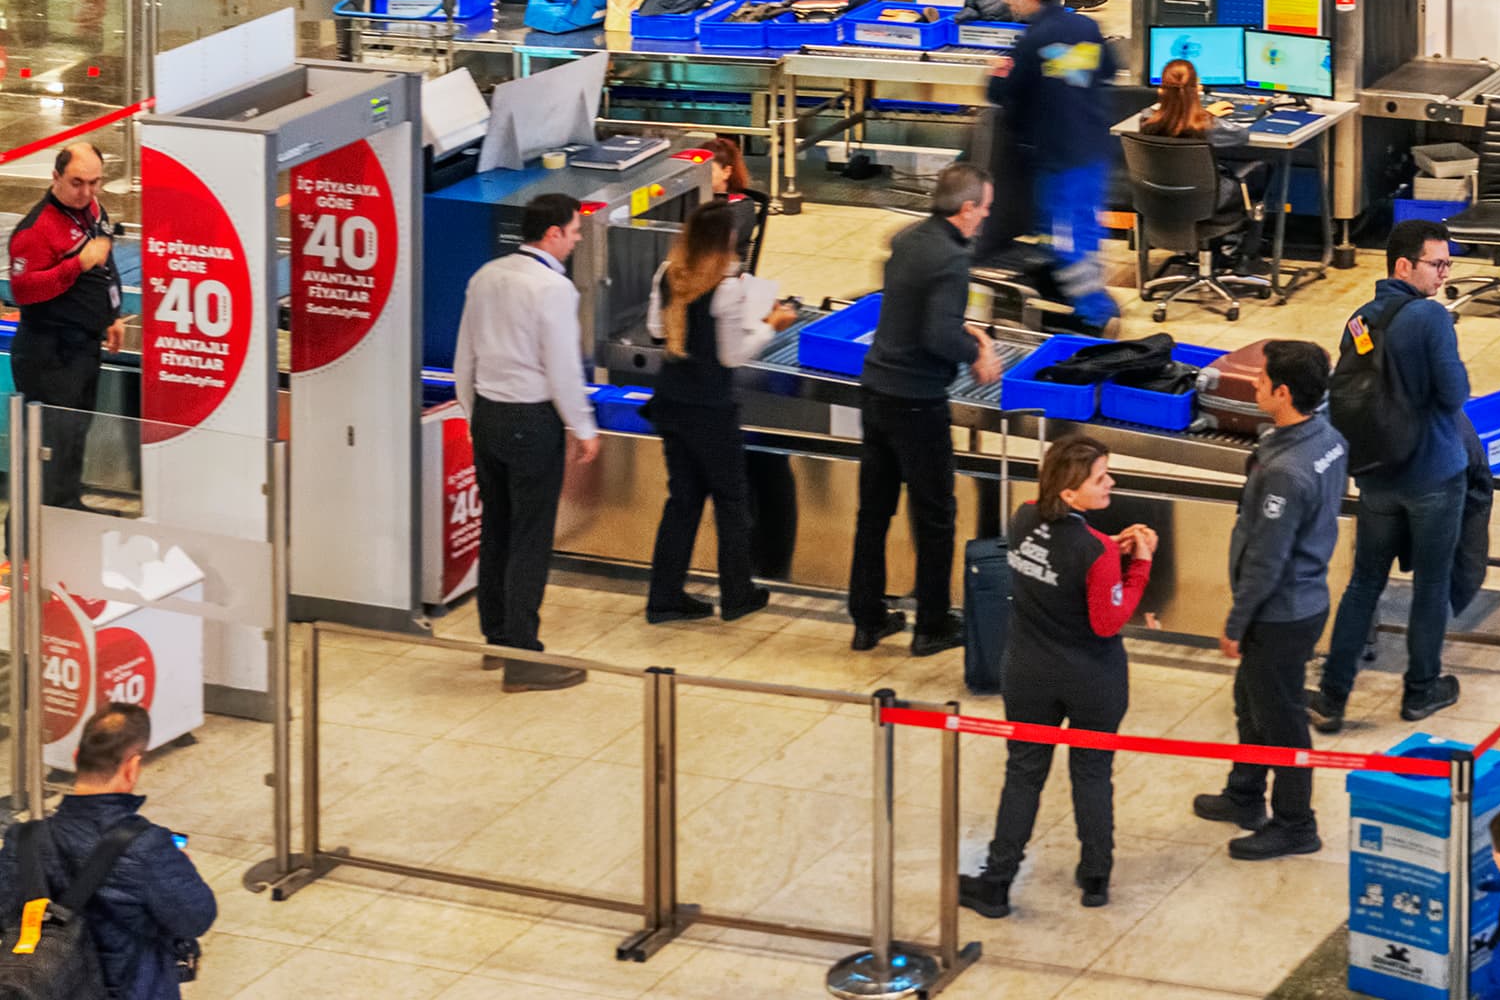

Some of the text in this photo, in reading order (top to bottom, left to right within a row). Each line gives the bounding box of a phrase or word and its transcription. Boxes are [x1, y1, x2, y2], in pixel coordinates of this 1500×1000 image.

[316, 178, 380, 197] PİYASAYA
[316, 194, 354, 210] GÖRE
[147, 237, 234, 260] İÇ PİYASAYA
[298, 213, 378, 271] %40
[168, 256, 207, 274] GÖRE
[302, 270, 375, 288] AVANTAJLI
[308, 284, 370, 303] FİYATLAR
[150, 277, 233, 337] %40
[154, 337, 230, 355] AVANTAJLI
[161, 350, 224, 371] FİYATLAR
